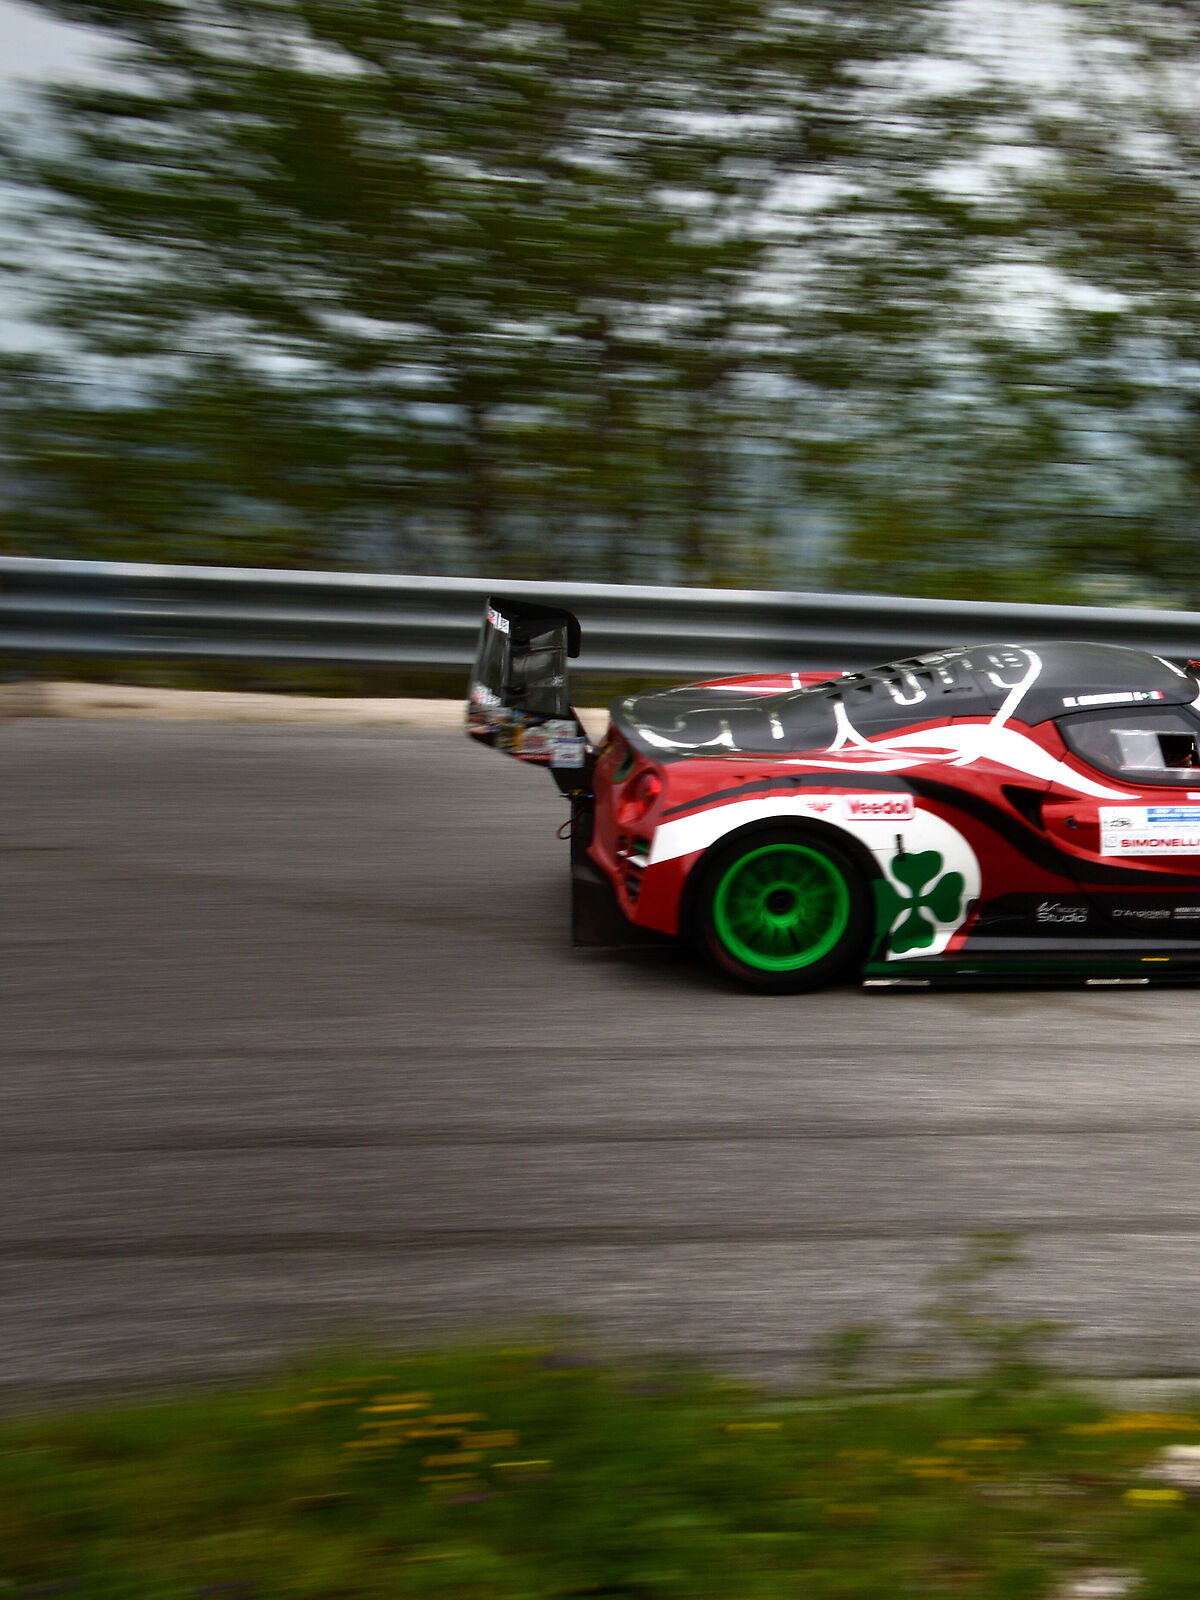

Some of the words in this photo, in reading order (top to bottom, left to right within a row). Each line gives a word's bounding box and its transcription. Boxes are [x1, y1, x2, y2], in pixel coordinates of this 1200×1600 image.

[847, 799, 909, 814] Veedol
[1120, 838, 1200, 848] SIMONELLI
[1037, 912, 1088, 923] Studio
